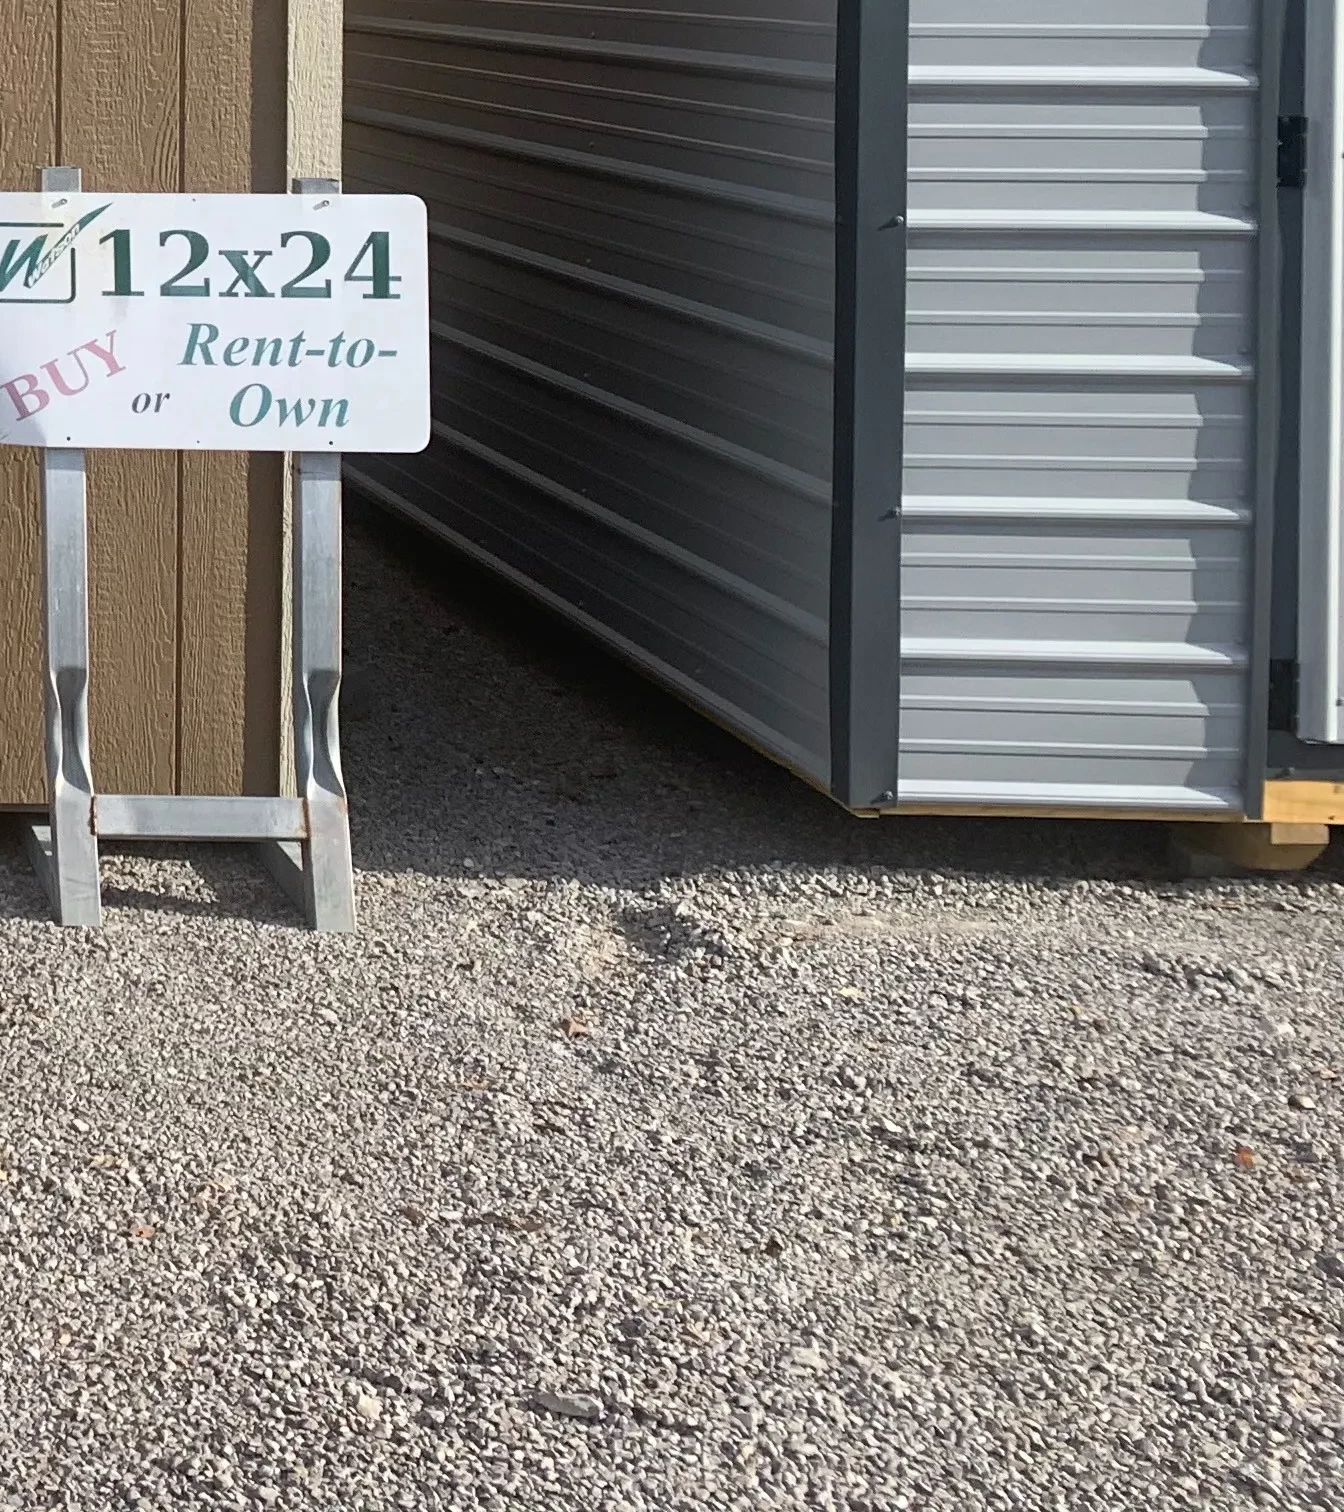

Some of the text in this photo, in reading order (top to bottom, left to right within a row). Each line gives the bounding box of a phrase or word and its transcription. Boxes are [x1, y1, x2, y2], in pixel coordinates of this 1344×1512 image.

[99, 229, 403, 300] 12x24
[177, 322, 398, 368] Rent-to-
[0, 329, 127, 421] BUY
[131, 392, 171, 414] or
[229, 383, 350, 428] Own
